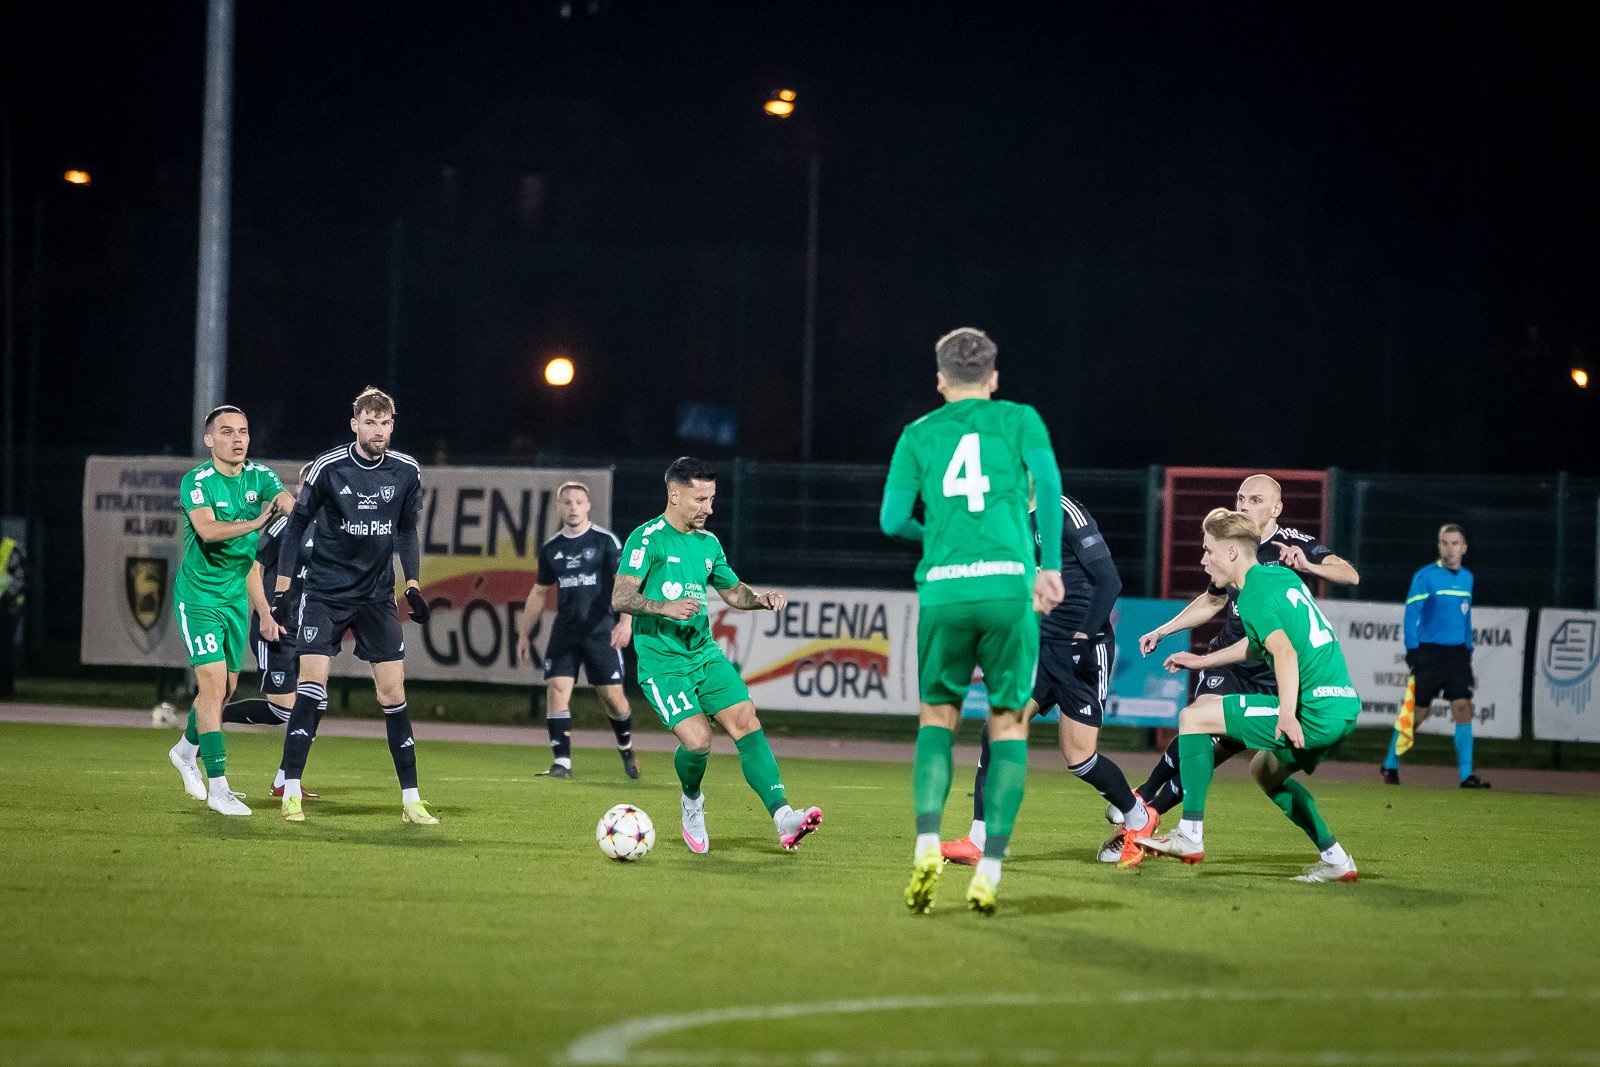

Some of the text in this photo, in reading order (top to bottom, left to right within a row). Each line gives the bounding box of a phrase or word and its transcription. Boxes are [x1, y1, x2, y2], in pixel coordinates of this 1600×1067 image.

[943, 433, 990, 512] 4
[370, 519, 393, 535] Plast
[422, 575, 545, 669] GÓR
[763, 600, 889, 641] JELENIA
[1349, 620, 1401, 642] NOWE
[194, 632, 219, 656] 18
[793, 648, 889, 700] GÓRA
[666, 691, 694, 717] 11
